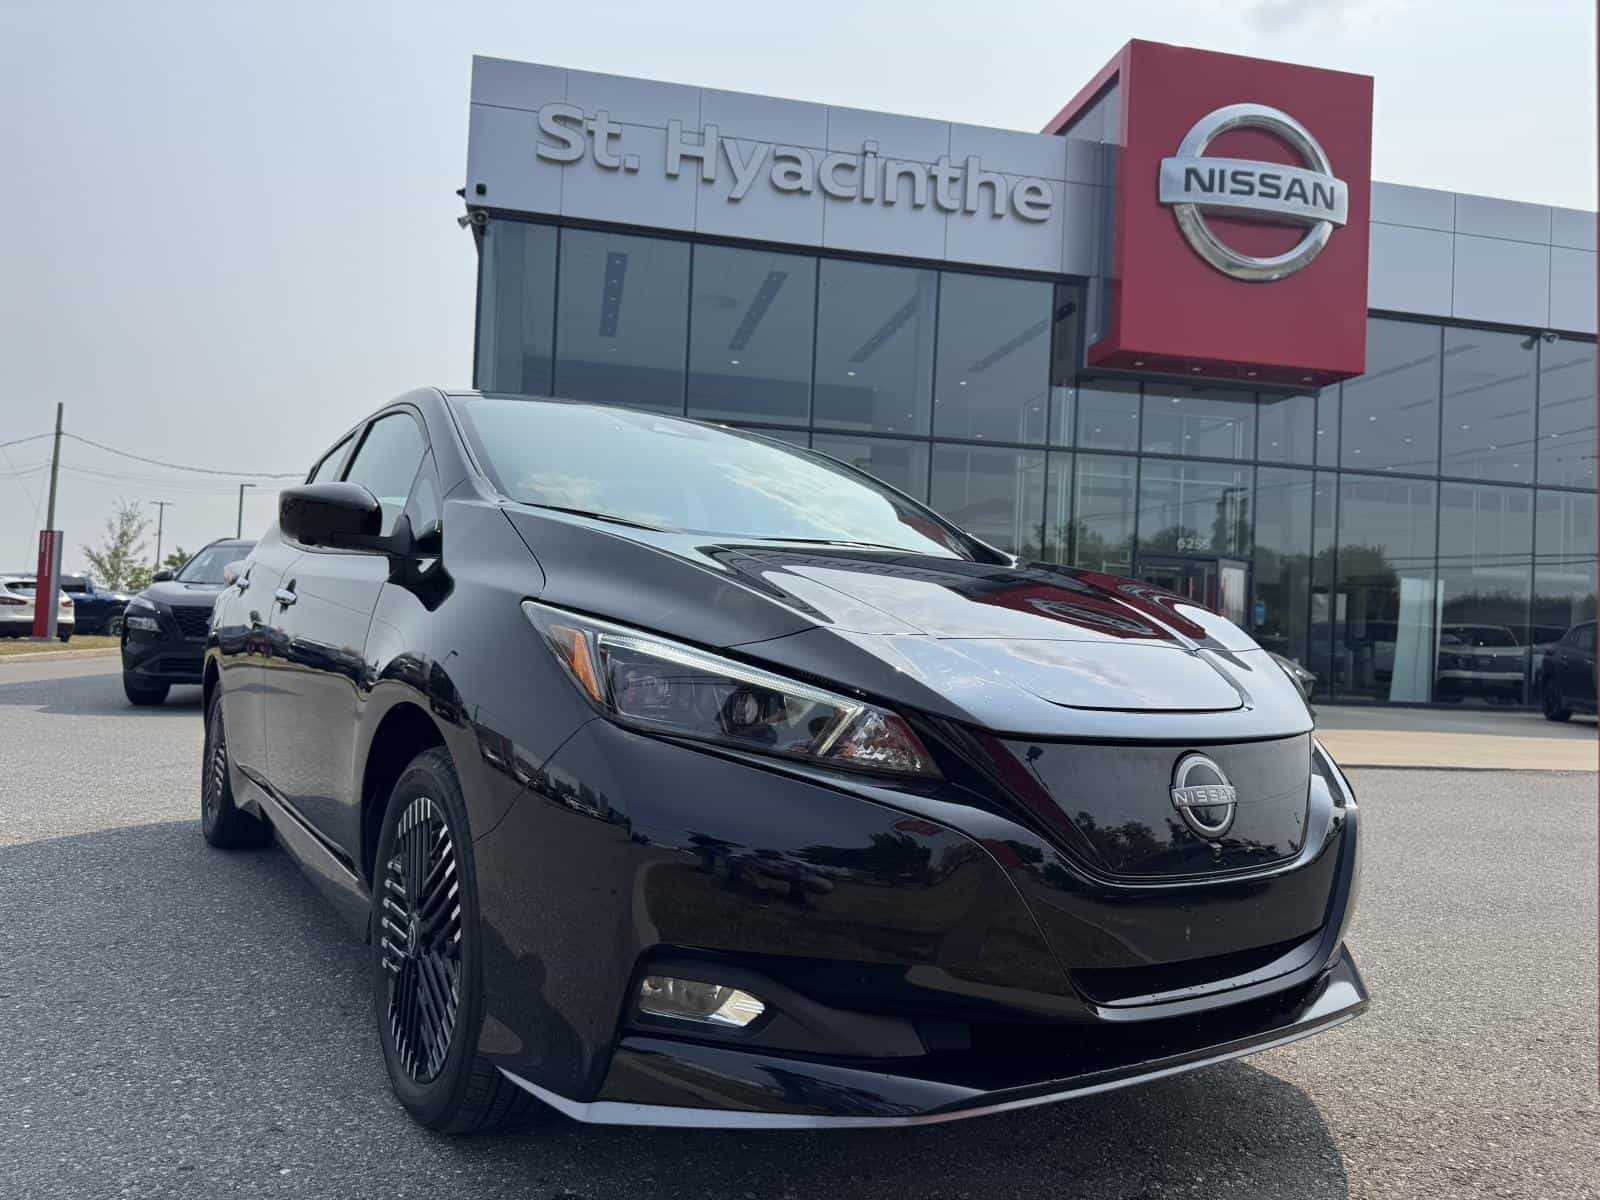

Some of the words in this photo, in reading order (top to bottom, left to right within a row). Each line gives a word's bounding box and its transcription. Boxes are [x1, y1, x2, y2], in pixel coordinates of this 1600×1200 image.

[535, 102, 640, 173] St.
[665, 118, 1054, 223] Hyacinthe
[1184, 167, 1335, 210] NISSAN
[1174, 789, 1236, 804] NISSAN
